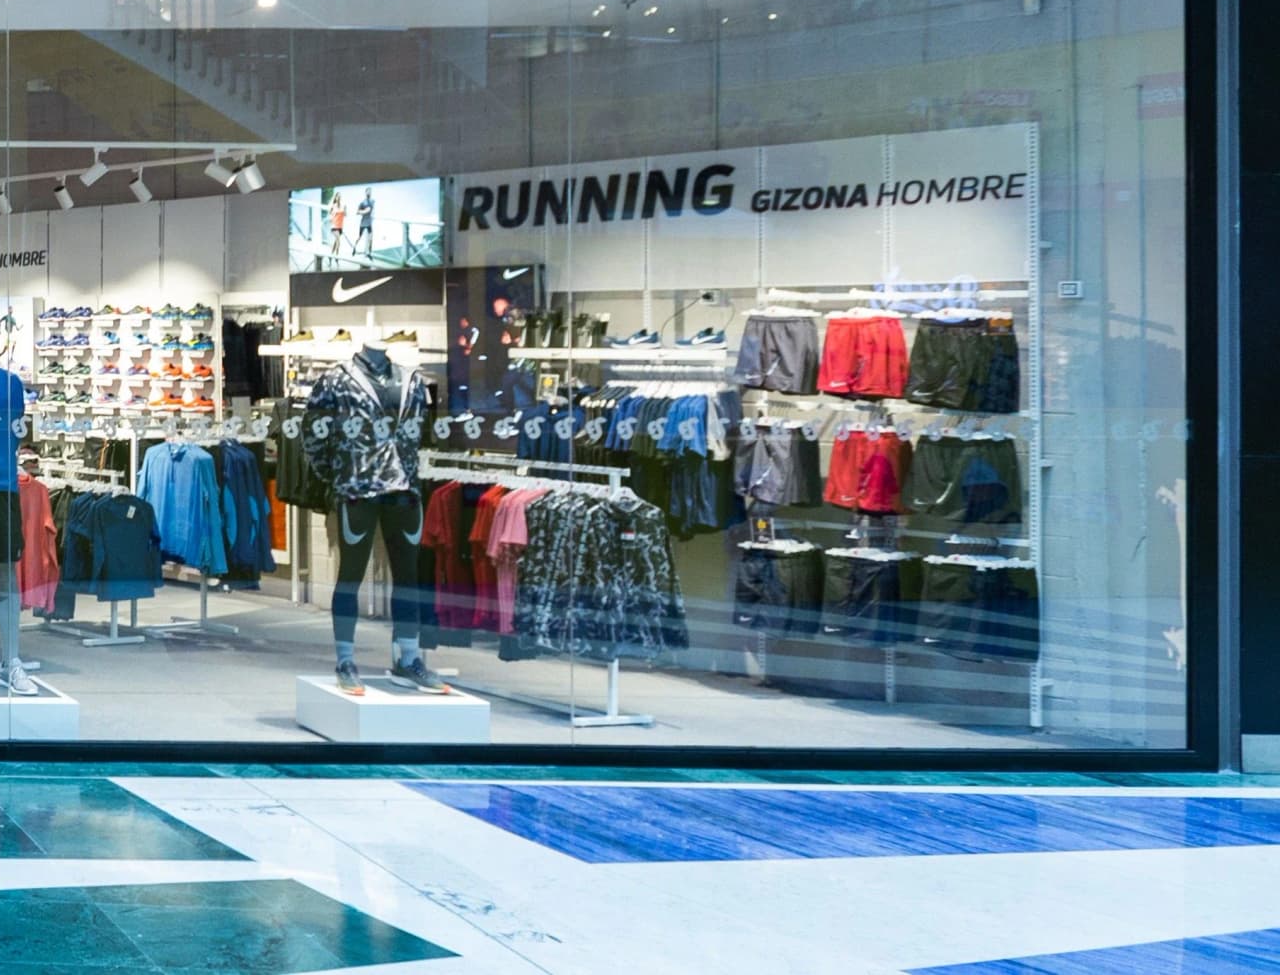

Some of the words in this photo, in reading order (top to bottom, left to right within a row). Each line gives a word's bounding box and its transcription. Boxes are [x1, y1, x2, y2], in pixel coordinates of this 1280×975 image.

[457, 163, 736, 232] RUNNING
[750, 182, 869, 213] GIZONA
[875, 172, 1028, 208] HOMBRE
